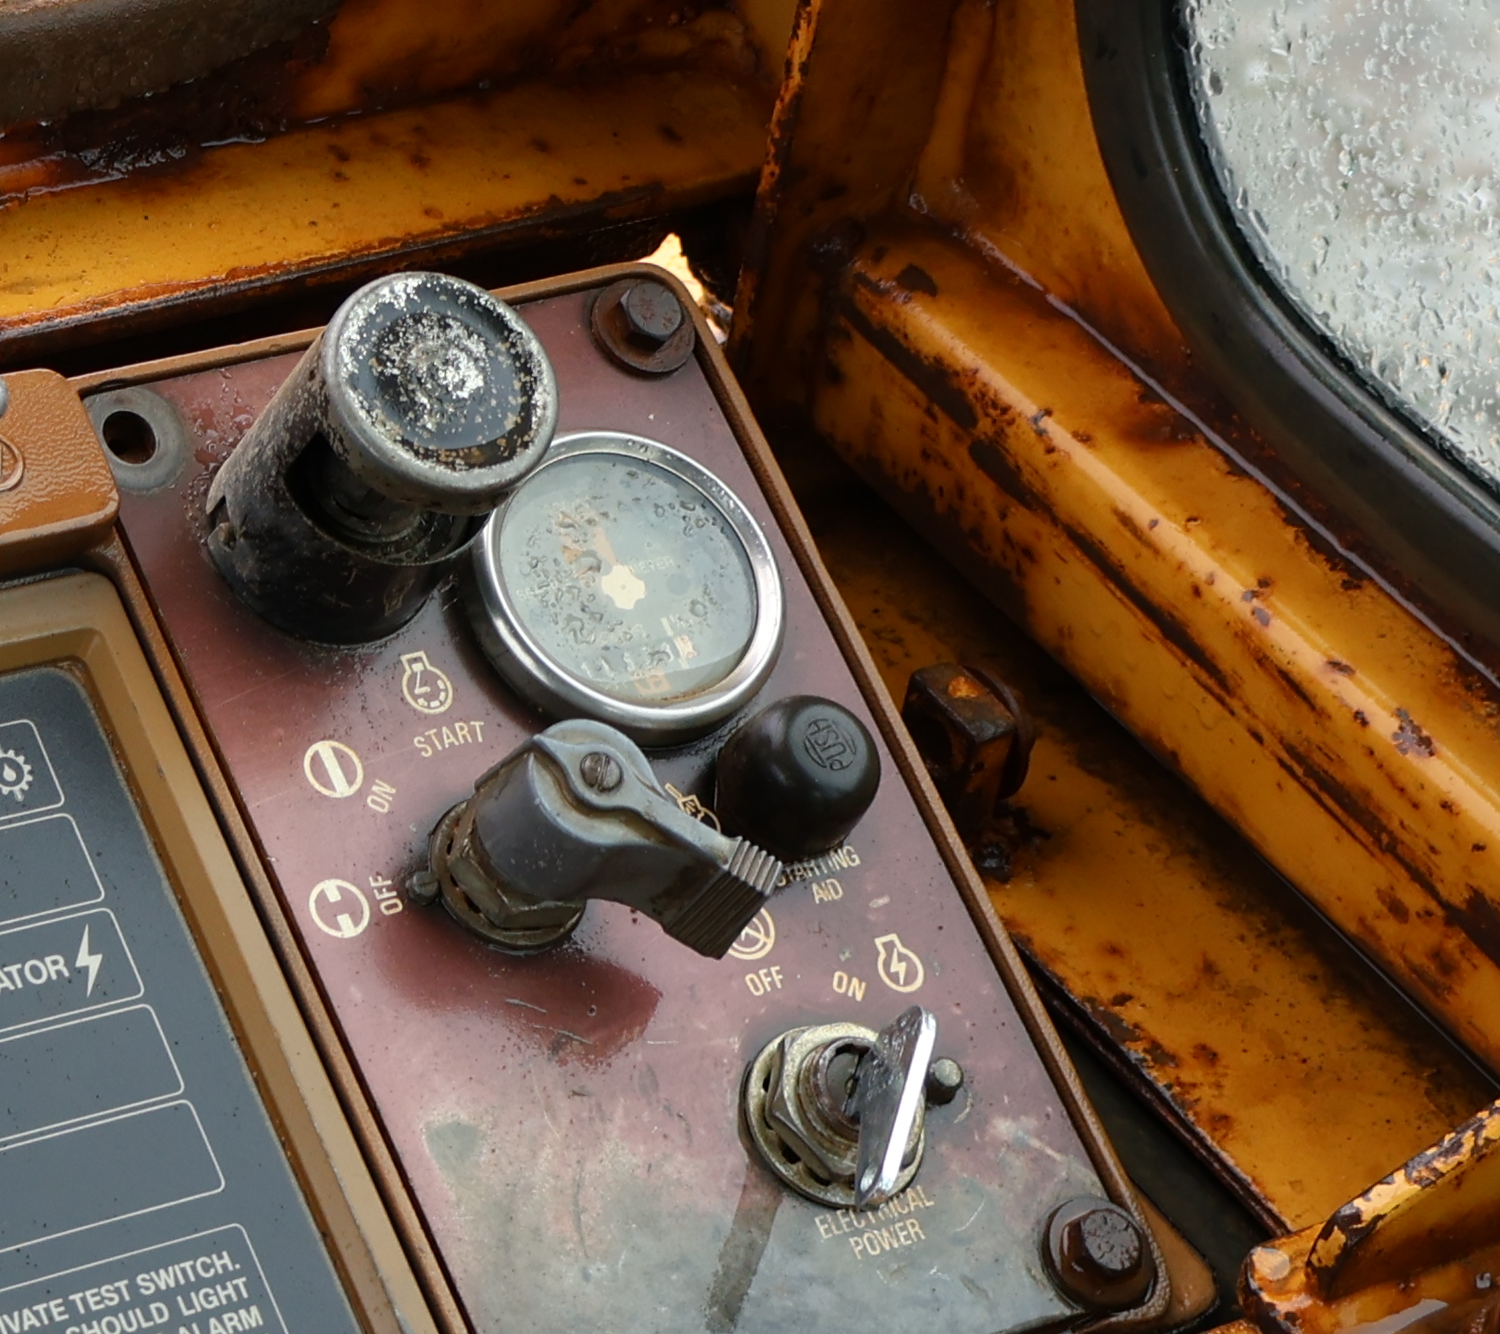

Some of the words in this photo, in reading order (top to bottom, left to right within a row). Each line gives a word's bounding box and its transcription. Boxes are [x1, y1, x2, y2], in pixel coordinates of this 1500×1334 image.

[413, 720, 485, 758] START
[806, 718, 854, 772] PUSH
[366, 779, 397, 814] ON
[368, 874, 404, 916] OFF
[811, 877, 844, 905] AID
[744, 965, 783, 997] OFF
[832, 970, 867, 1002] ON
[813, 1184, 935, 1240] ELECTRICAL
[848, 1217, 926, 1260] POWER
[68, 1279, 131, 1316] TEST
[135, 1250, 241, 1296] SWITCH.
[176, 1276, 251, 1318] LIGHT
